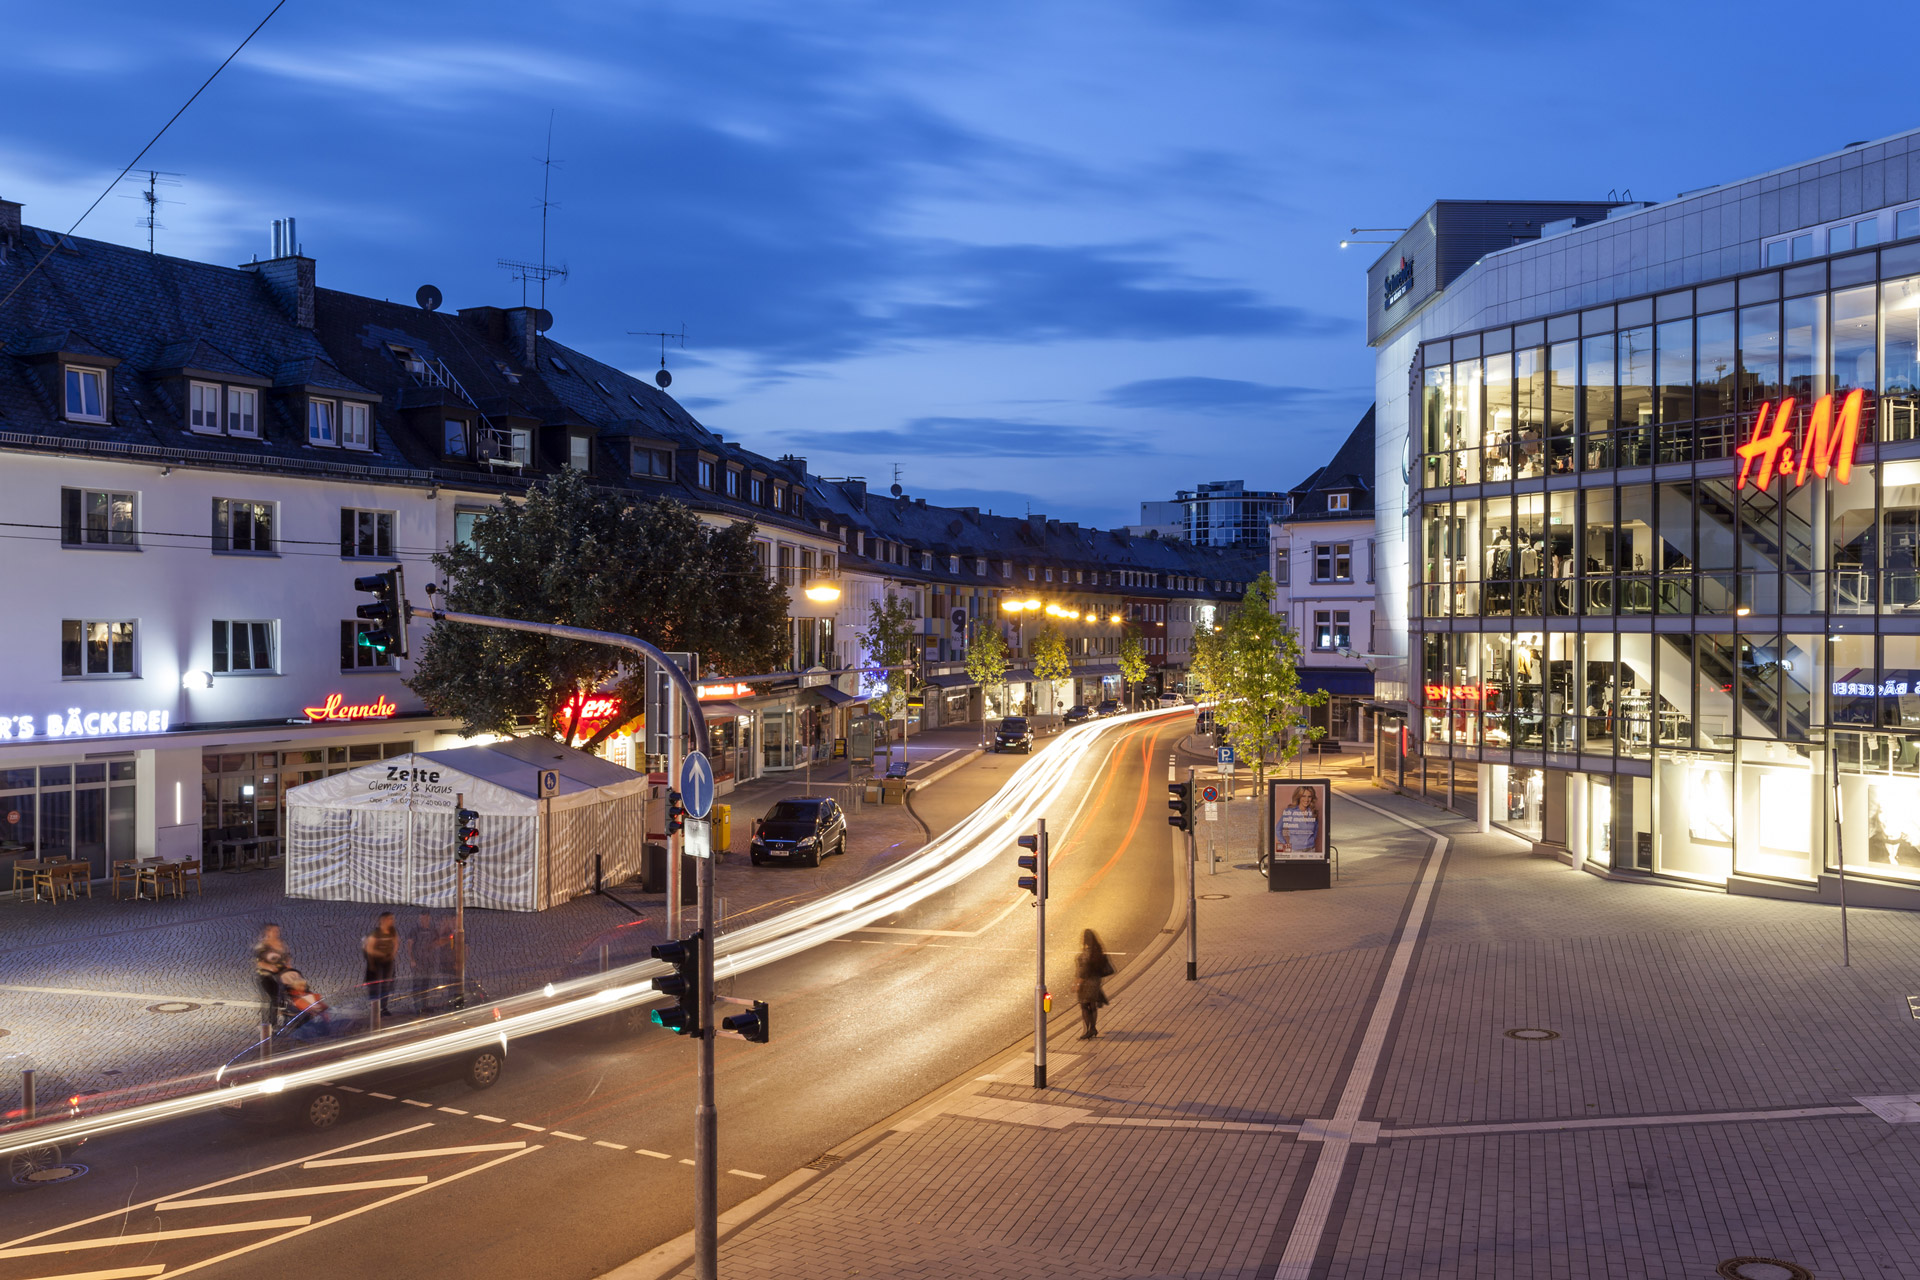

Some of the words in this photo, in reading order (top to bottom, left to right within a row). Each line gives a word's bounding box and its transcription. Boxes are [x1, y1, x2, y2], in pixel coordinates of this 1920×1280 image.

[1737, 388, 1864, 491] H&M
[303, 693, 396, 719] Hennche
[47, 707, 169, 737] BÄCKEREI
[1222, 749, 1230, 761] P
[387, 766, 440, 783] Zelte
[368, 781, 407, 792] Clemens
[412, 783, 419, 793] &
[425, 784, 453, 794] Kraus
